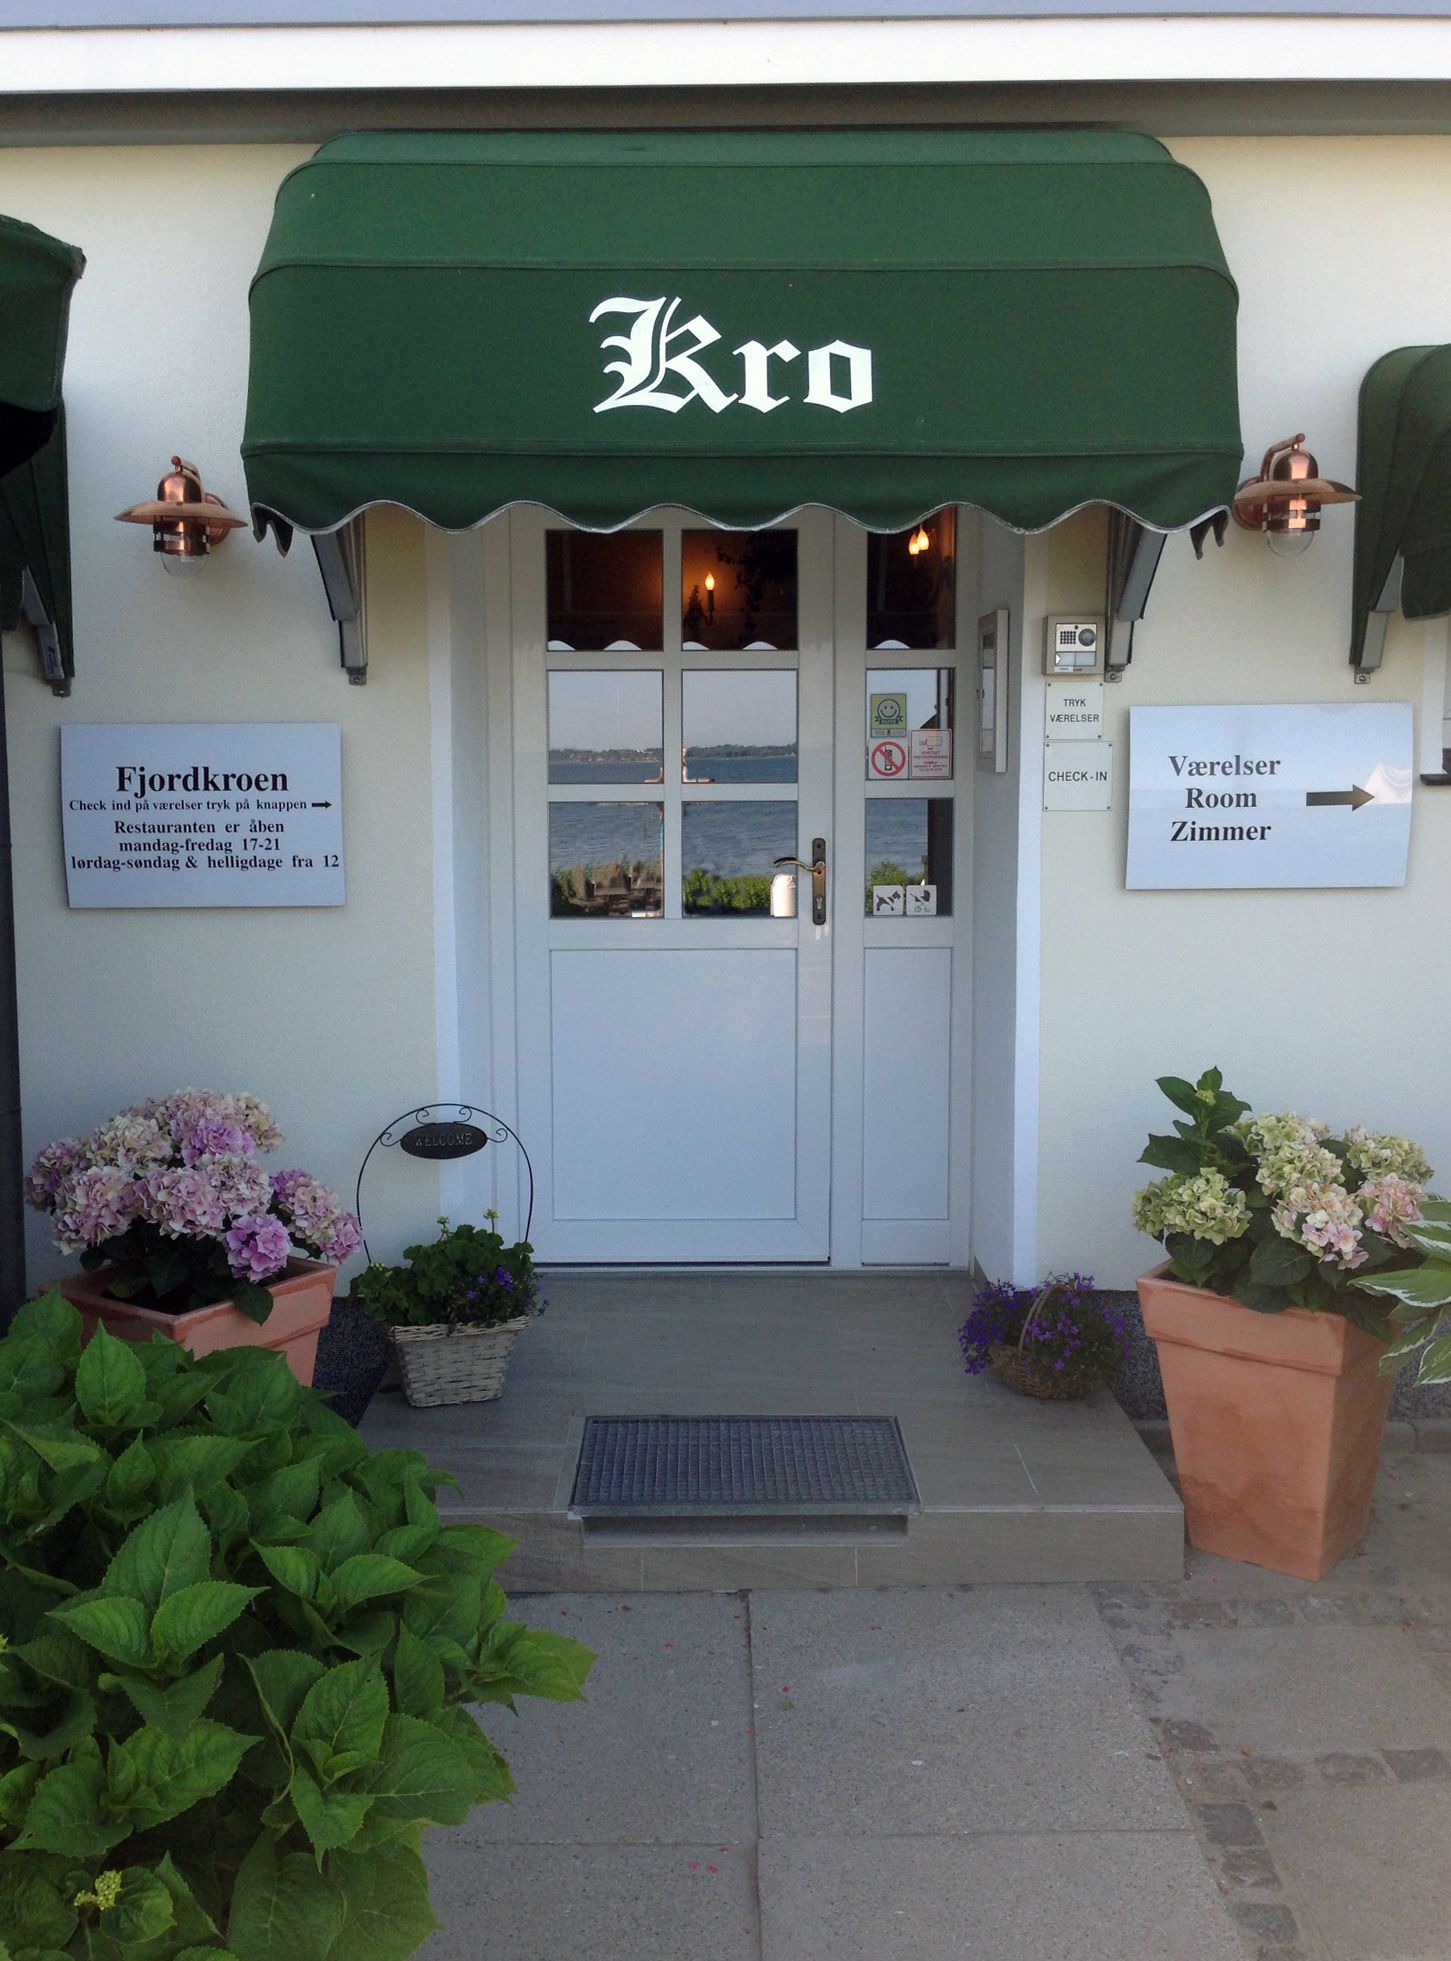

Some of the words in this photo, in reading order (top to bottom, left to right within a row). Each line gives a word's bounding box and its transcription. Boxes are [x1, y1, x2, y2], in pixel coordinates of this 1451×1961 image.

[588, 296, 873, 414] Kro
[1063, 698, 1087, 708] TRYK
[1049, 713, 1100, 723] VÆRELSER
[1168, 754, 1281, 777] Værelser
[115, 765, 289, 798] Fjordkroen
[69, 799, 107, 811] Check
[112, 799, 131, 811] ind
[135, 798, 149, 813] på
[153, 799, 203, 811] værelser
[206, 799, 231, 813] tryk
[236, 798, 250, 813] på
[256, 799, 307, 813] knappen
[1185, 787, 1258, 809] Room
[114, 820, 216, 834] Restauranten
[225, 822, 240, 833] er
[249, 819, 284, 833] åben
[1170, 820, 1272, 842] Zimmer
[119, 838, 233, 854] mandag-fredag
[242, 838, 281, 851] 17-21
[71, 855, 180, 872] lørdag-søndag
[185, 855, 198, 869] &
[207, 855, 283, 872] helligdage
[292, 855, 313, 868] fra
[323, 855, 340, 868] 12
[415, 1133, 473, 1147] WELCOME
